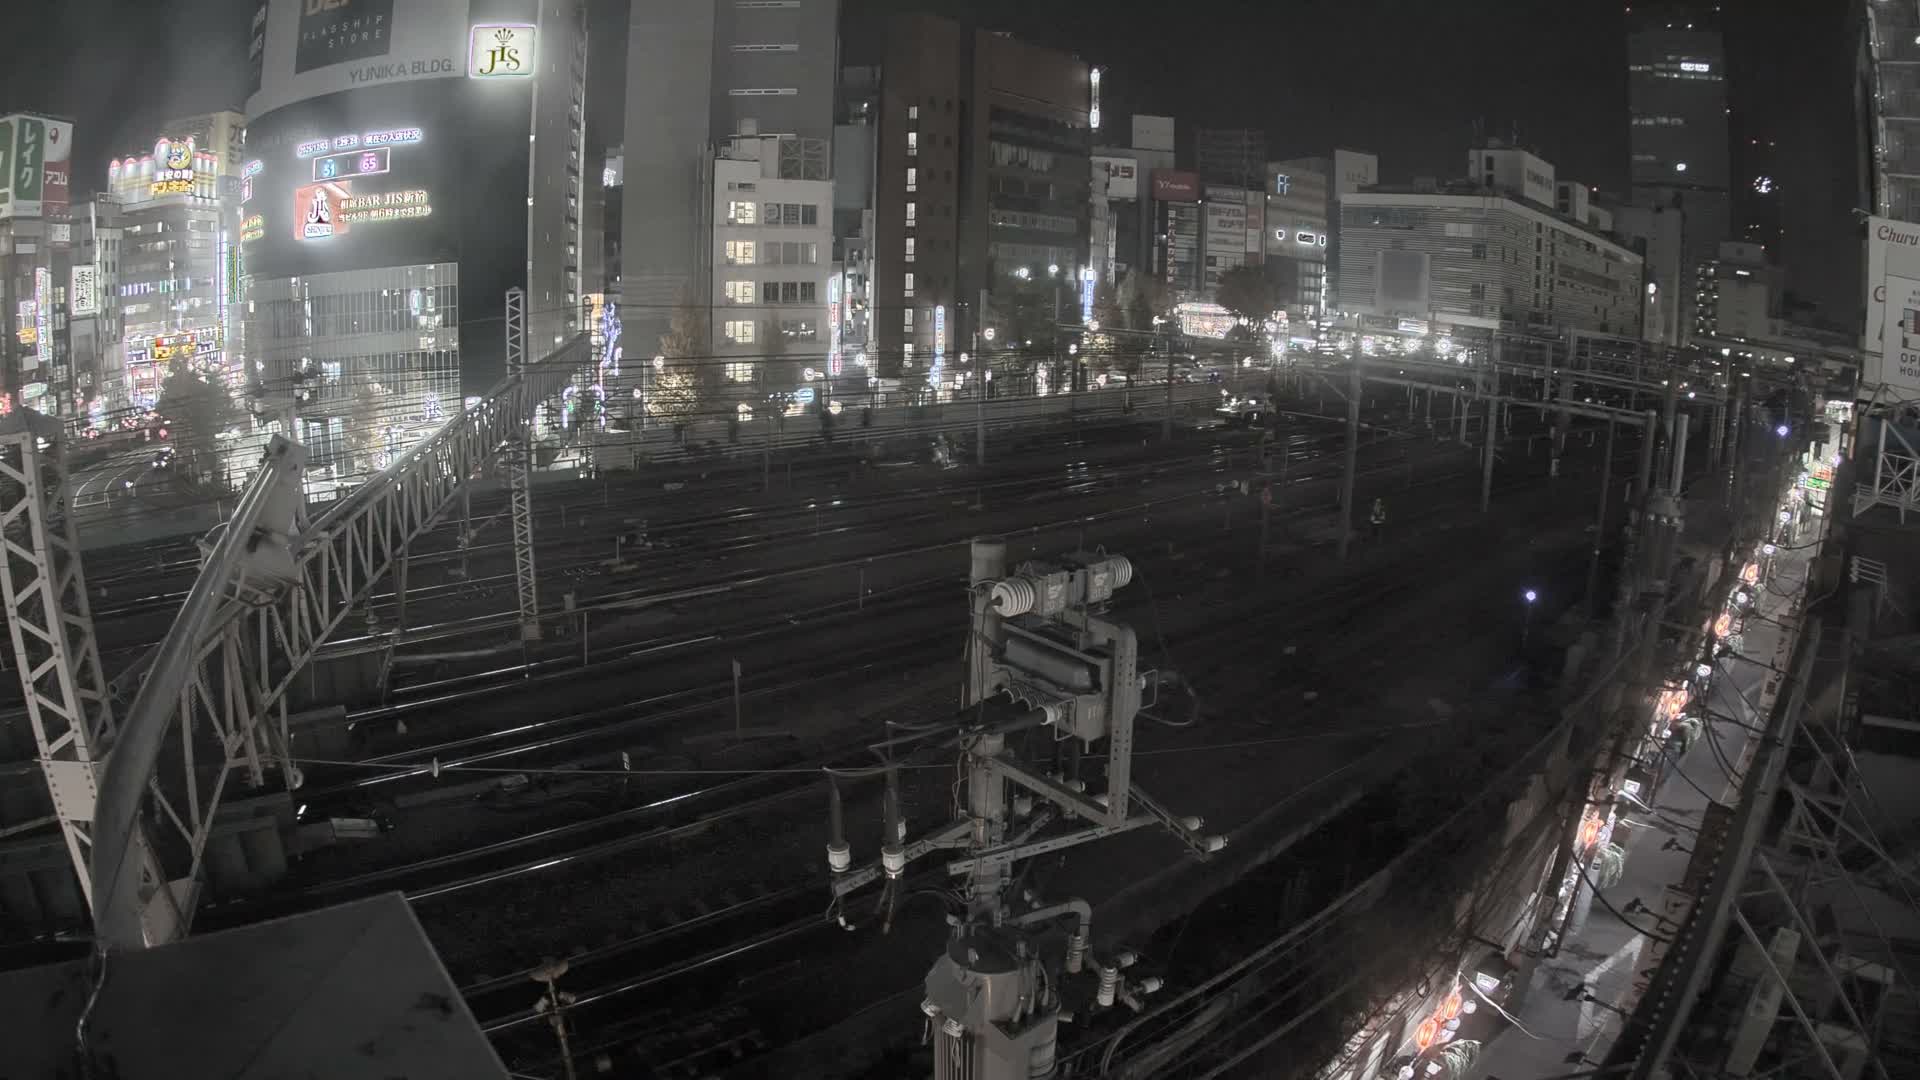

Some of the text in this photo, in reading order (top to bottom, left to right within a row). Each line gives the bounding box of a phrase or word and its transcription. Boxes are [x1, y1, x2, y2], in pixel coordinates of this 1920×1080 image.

[328, 29, 382, 48] STORE
[479, 45, 520, 74] JIS
[350, 58, 456, 83] YUNIKA BLDG.
[20, 122, 36, 189] レイク
[362, 158, 376, 170] 65
[45, 170, 68, 185] アコム
[1878, 225, 1919, 246] Churu
[1900, 352, 1920, 366] OP
